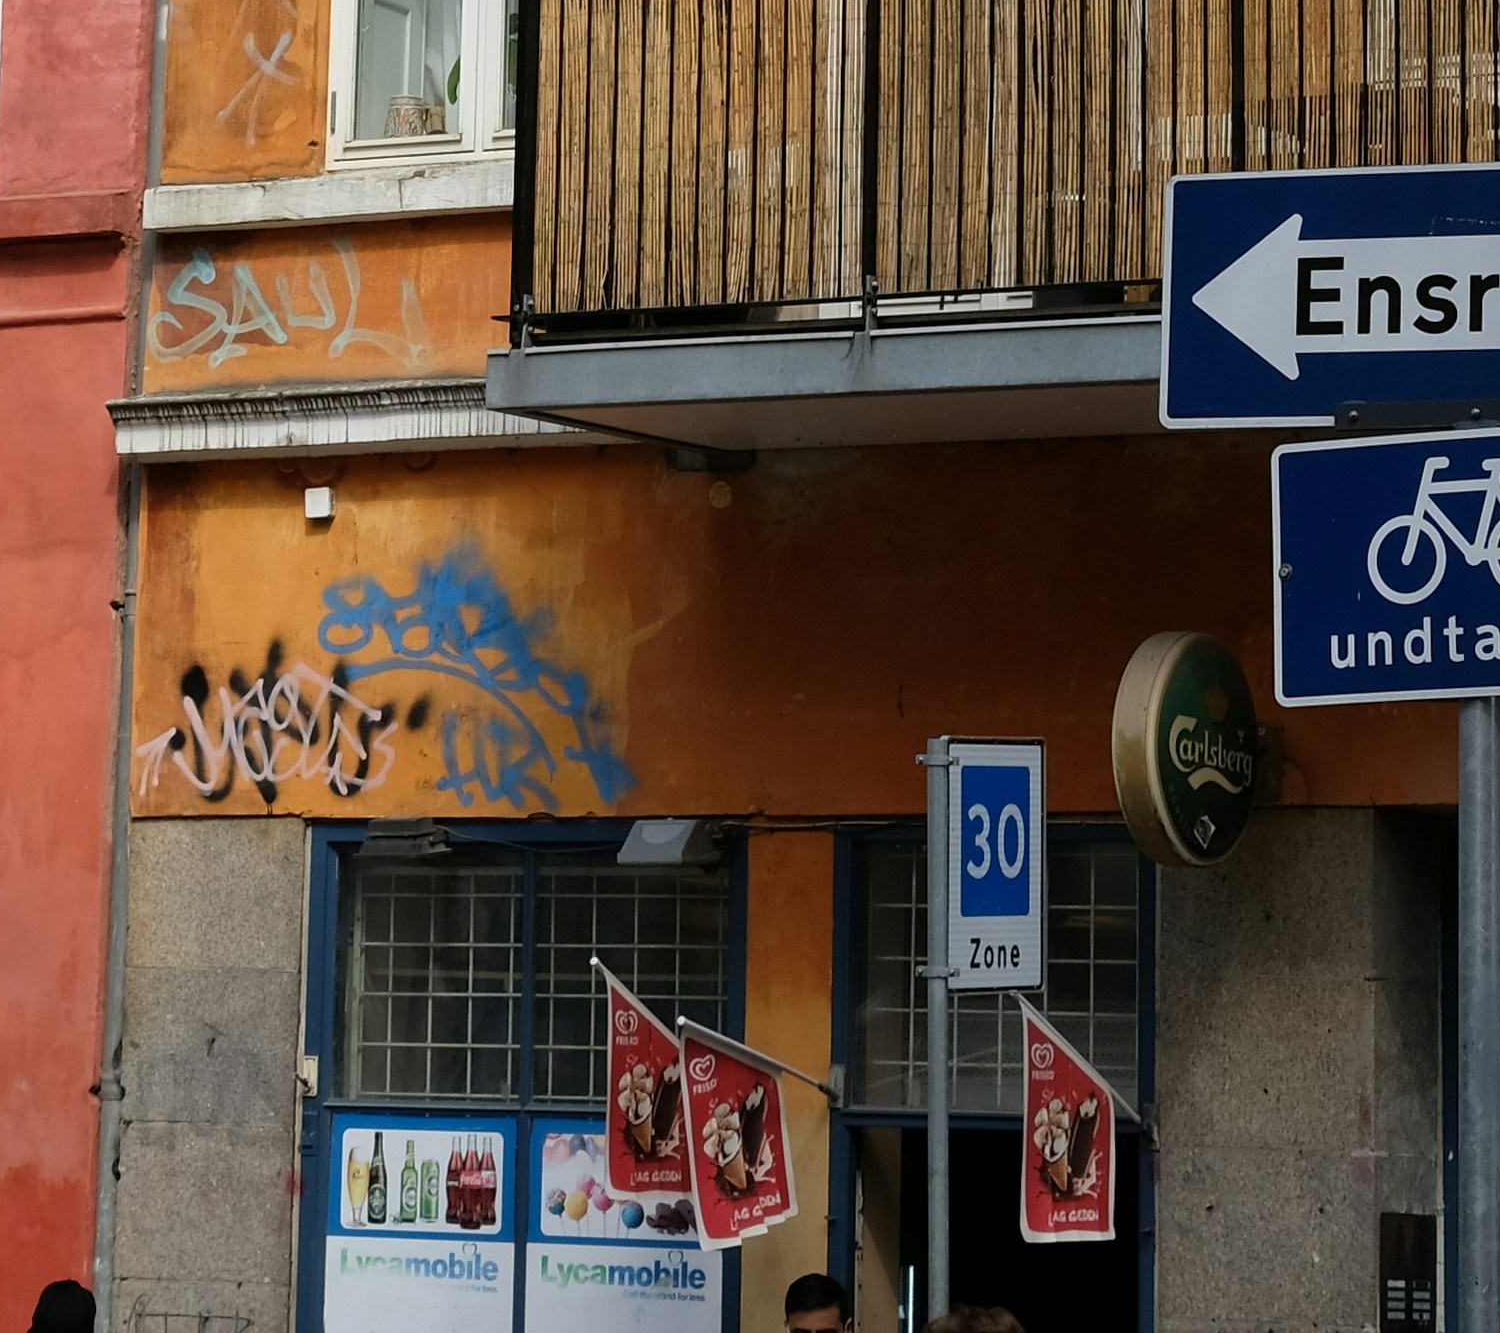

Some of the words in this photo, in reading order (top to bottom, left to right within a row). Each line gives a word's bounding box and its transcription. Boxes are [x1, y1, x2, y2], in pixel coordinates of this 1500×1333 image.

[1168, 714, 1254, 786] Carlsberg
[966, 802, 1026, 881] 30
[969, 937, 1022, 971] Zone
[540, 1251, 707, 1290] Lycamobile
